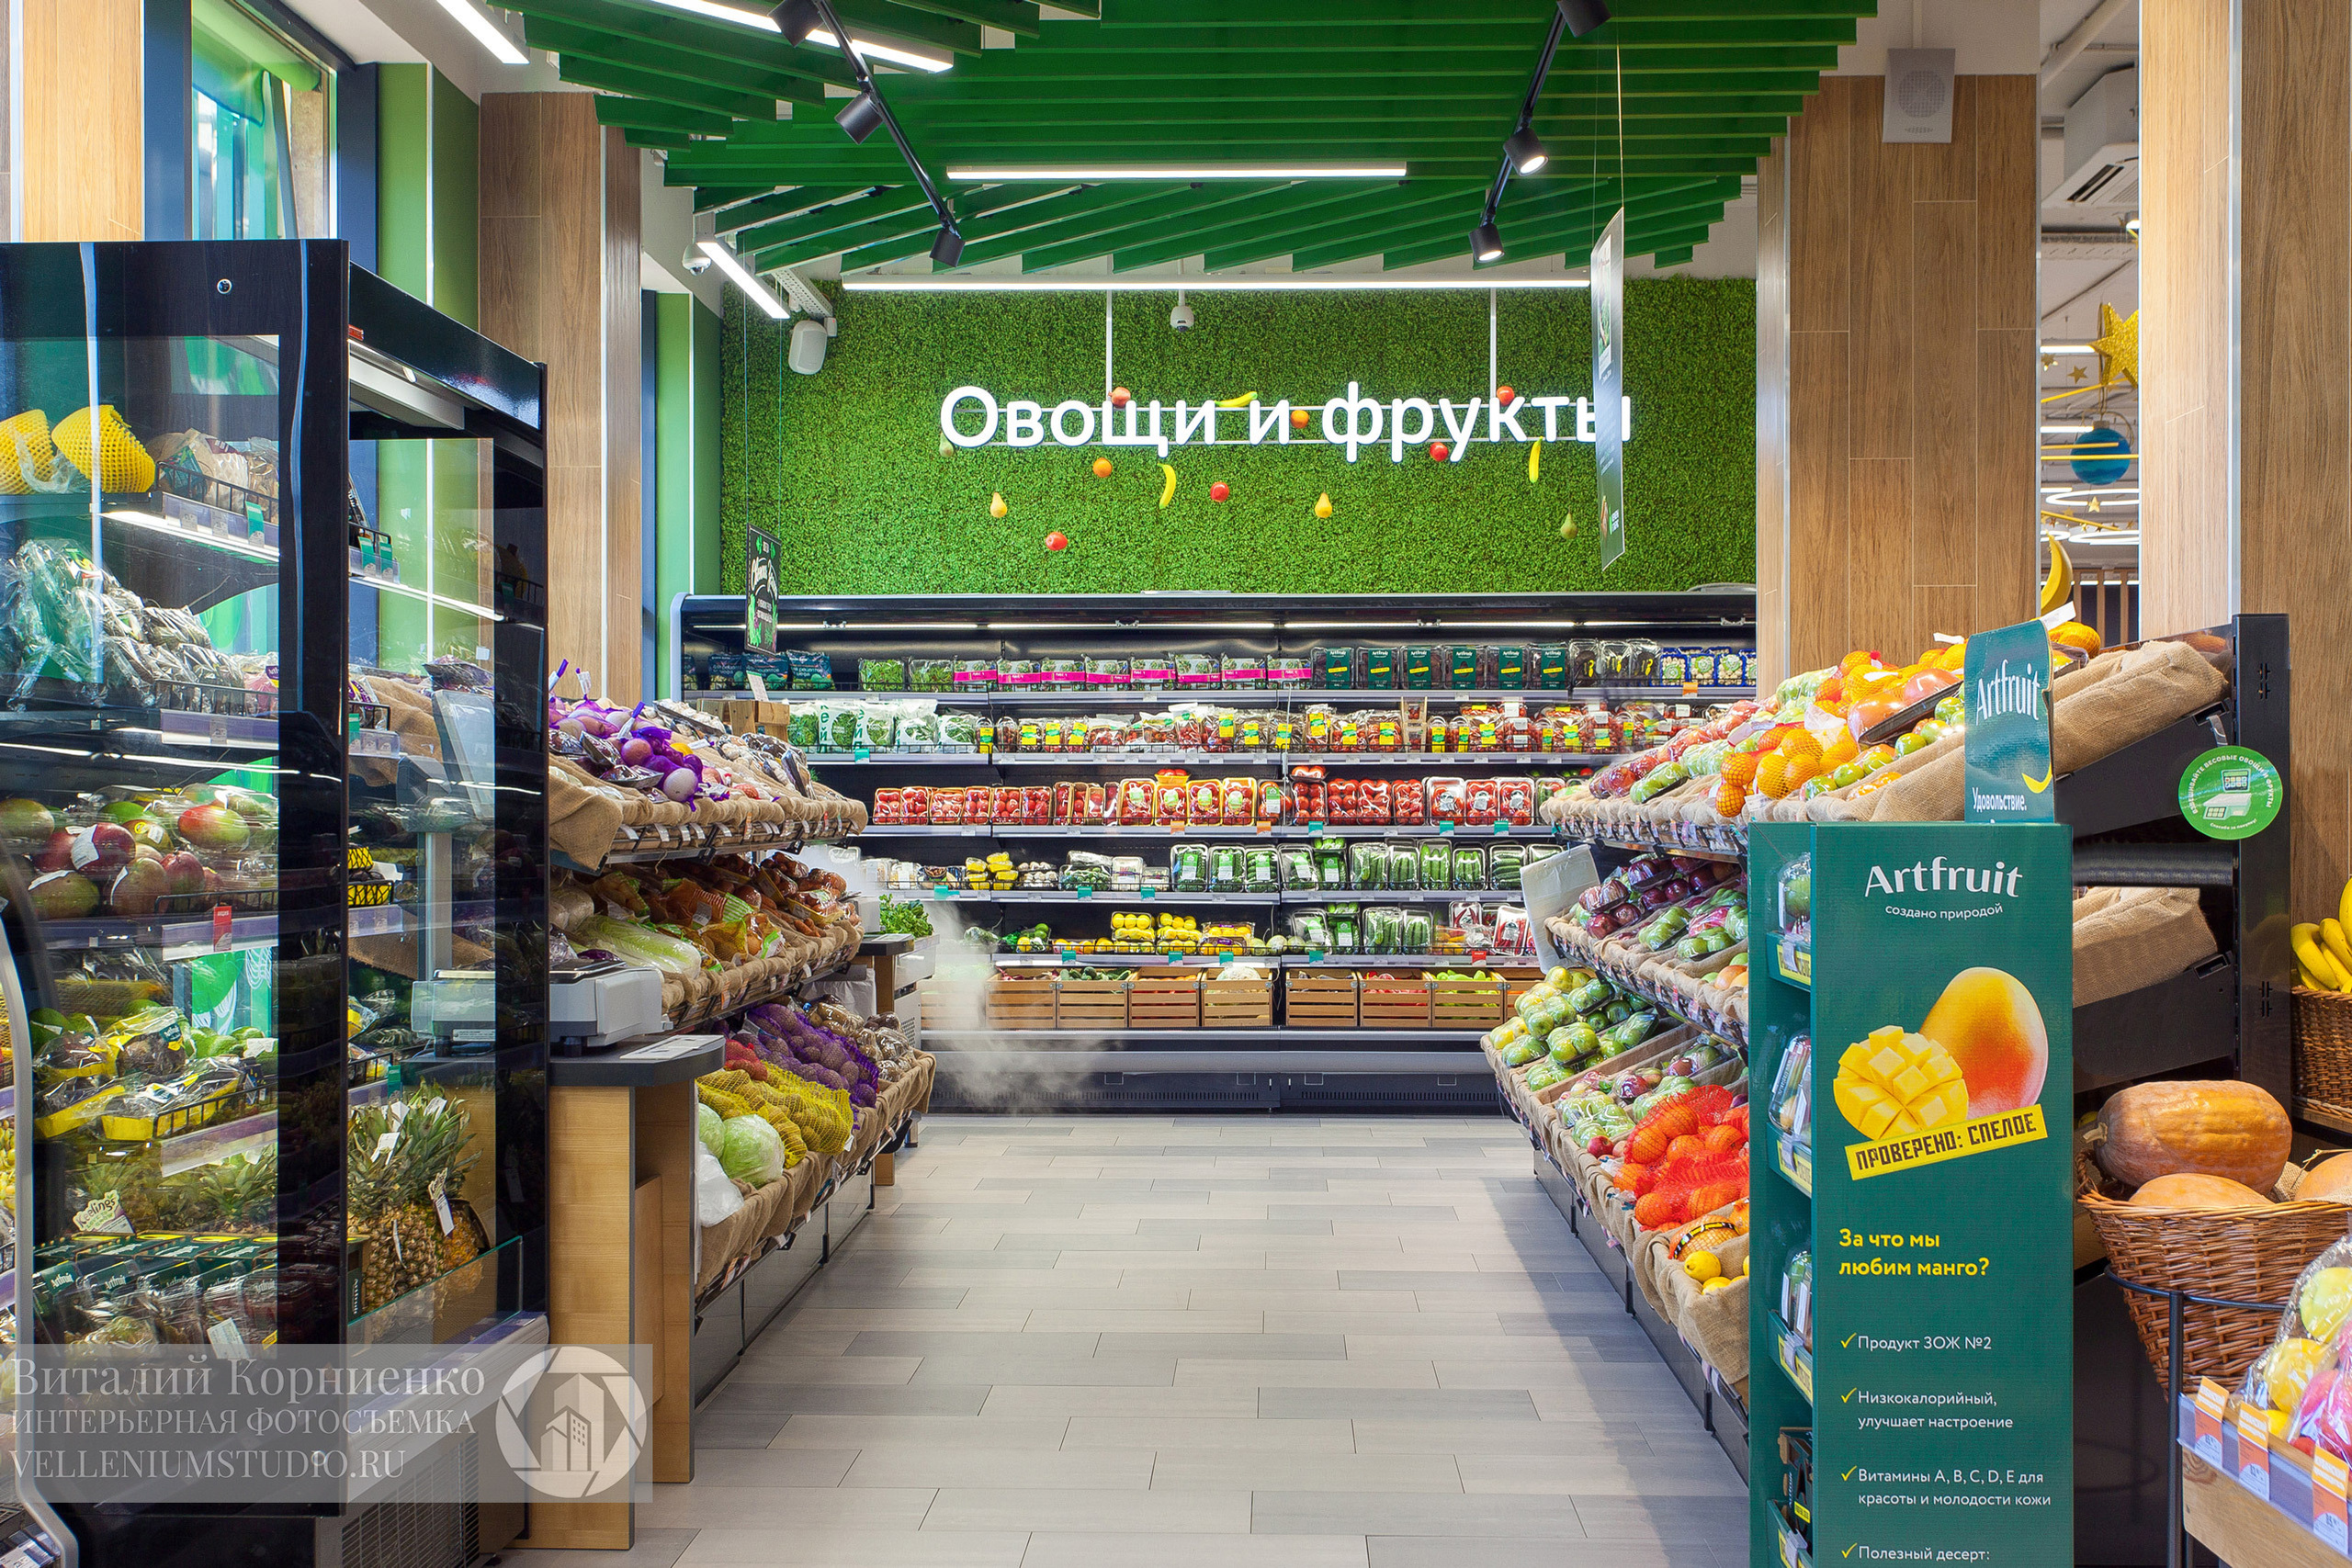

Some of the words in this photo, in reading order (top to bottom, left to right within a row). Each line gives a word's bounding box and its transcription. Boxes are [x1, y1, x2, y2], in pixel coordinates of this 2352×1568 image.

[940, 385, 1217, 458] Овощи
[1250, 399, 1288, 446] и
[1975, 660, 2041, 726] Artfruit
[2188, 767, 2205, 814] ВЗВЕШИВАЙТЕ
[2204, 755, 2237, 768] ВЕСОВЫЕ
[2239, 756, 2265, 773] ОВОЩИ
[2266, 779, 2274, 808] ФРУКТЫ
[1973, 787, 2027, 813] Удовольствие.
[1864, 856, 2023, 897] Artfruit
[1884, 903, 1937, 919] создано
[1939, 901, 2003, 921] природой
[1855, 1130, 1963, 1171] ПРОВЕРЕНО:
[1970, 1112, 2037, 1146] СПЕЛОЕ
[76, 1198, 116, 1228] Keelings
[1839, 1228, 1863, 1247] За
[1869, 1233, 1905, 1247] что
[1910, 1233, 1940, 1247] мы
[1838, 1258, 1912, 1276] любим
[1917, 1258, 1990, 1276] манго?
[50, 1274, 74, 1289] Artfruit
[1858, 1336, 1919, 1353] Продукт
[1924, 1336, 1961, 1349] ЗОЖ
[1964, 1336, 1992, 1349] №2
[1858, 1390, 1997, 1406] Низкокалорийный,
[1858, 1416, 1925, 1429] улучшает
[1928, 1416, 2014, 1430] настроение
[1858, 1470, 1930, 1483] Витамины
[1934, 1471, 1950, 1485] A,
[1953, 1471, 1967, 1485] B,
[1970, 1471, 1984, 1485] C,
[1987, 1471, 2003, 1485] D,
[2007, 1472, 2015, 1483] E
[2018, 1473, 2044, 1485] для
[1858, 1493, 1917, 1506] красоты
[1920, 1495, 1929, 1505] и
[1933, 1493, 2011, 1506] молодости
[2015, 1495, 2051, 1506] кожи
[1858, 1545, 1932, 1560] Полезный
[1936, 1549, 1990, 1563] десерт:
